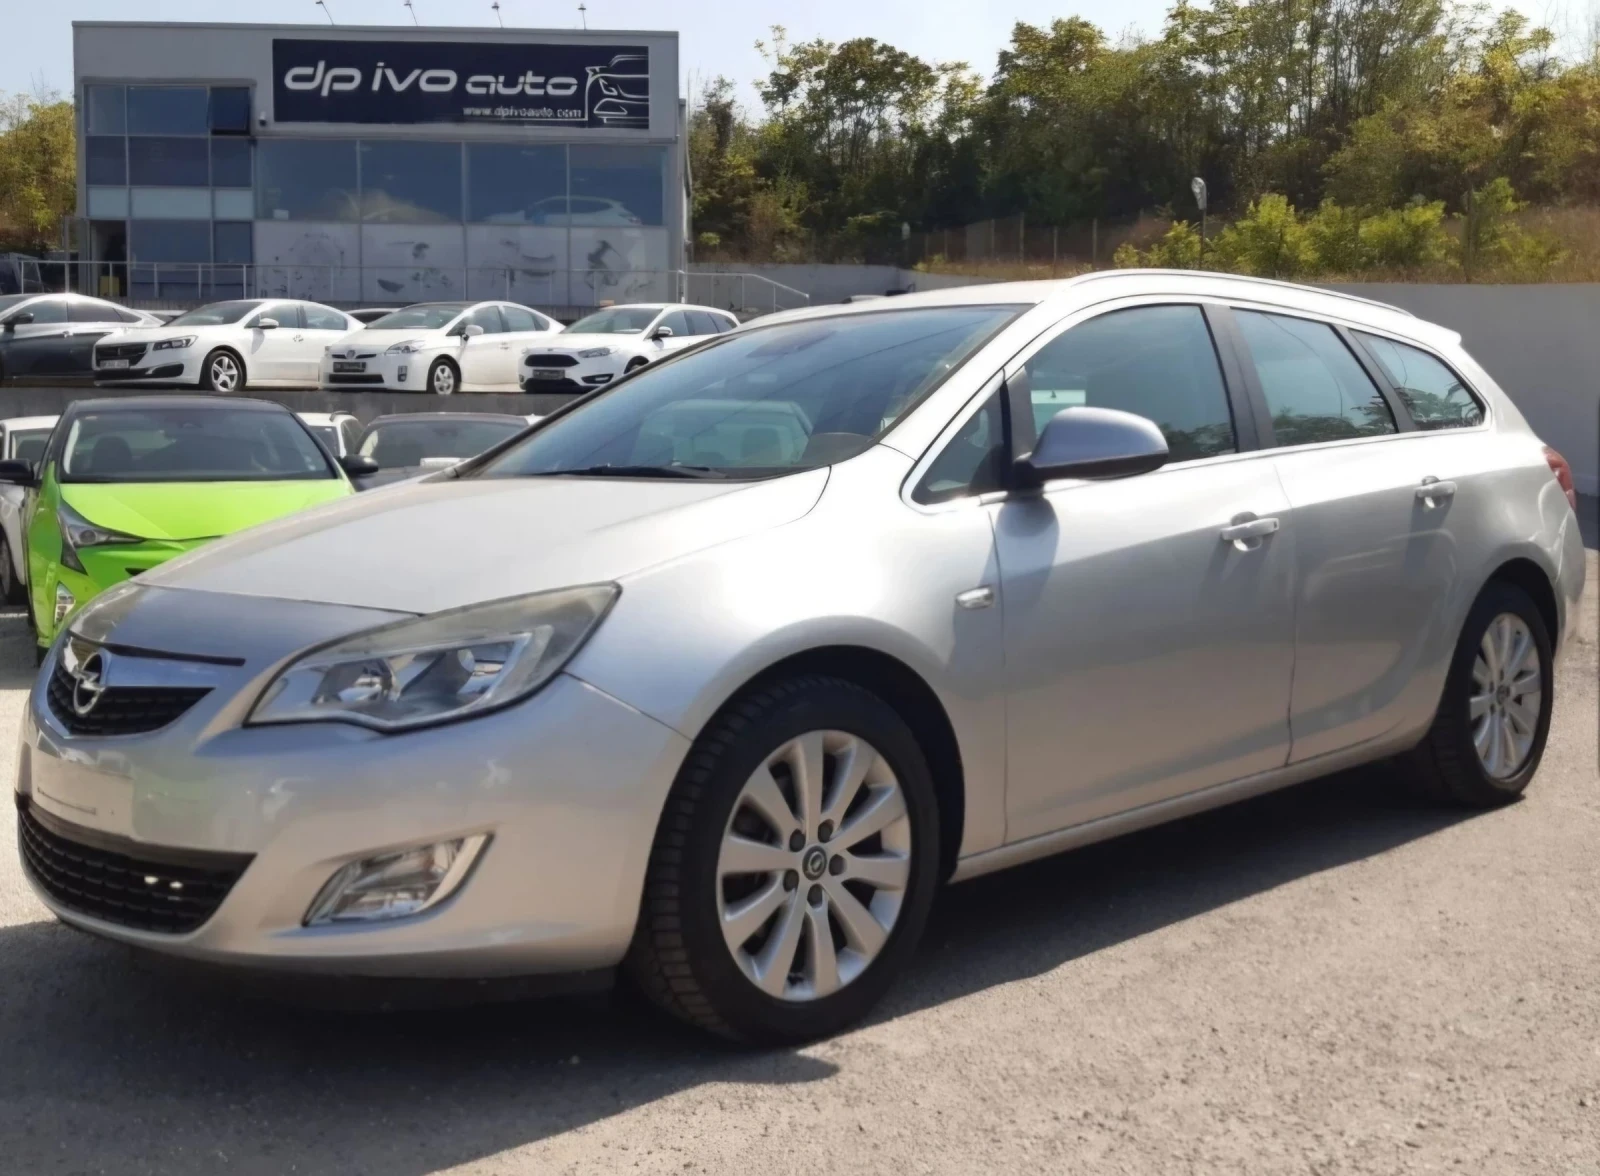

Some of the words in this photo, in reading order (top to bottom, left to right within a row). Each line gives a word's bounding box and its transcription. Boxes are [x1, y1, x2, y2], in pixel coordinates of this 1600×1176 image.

[284, 60, 362, 97] dp
[371, 62, 457, 92] ivo
[465, 70, 578, 95] auto
